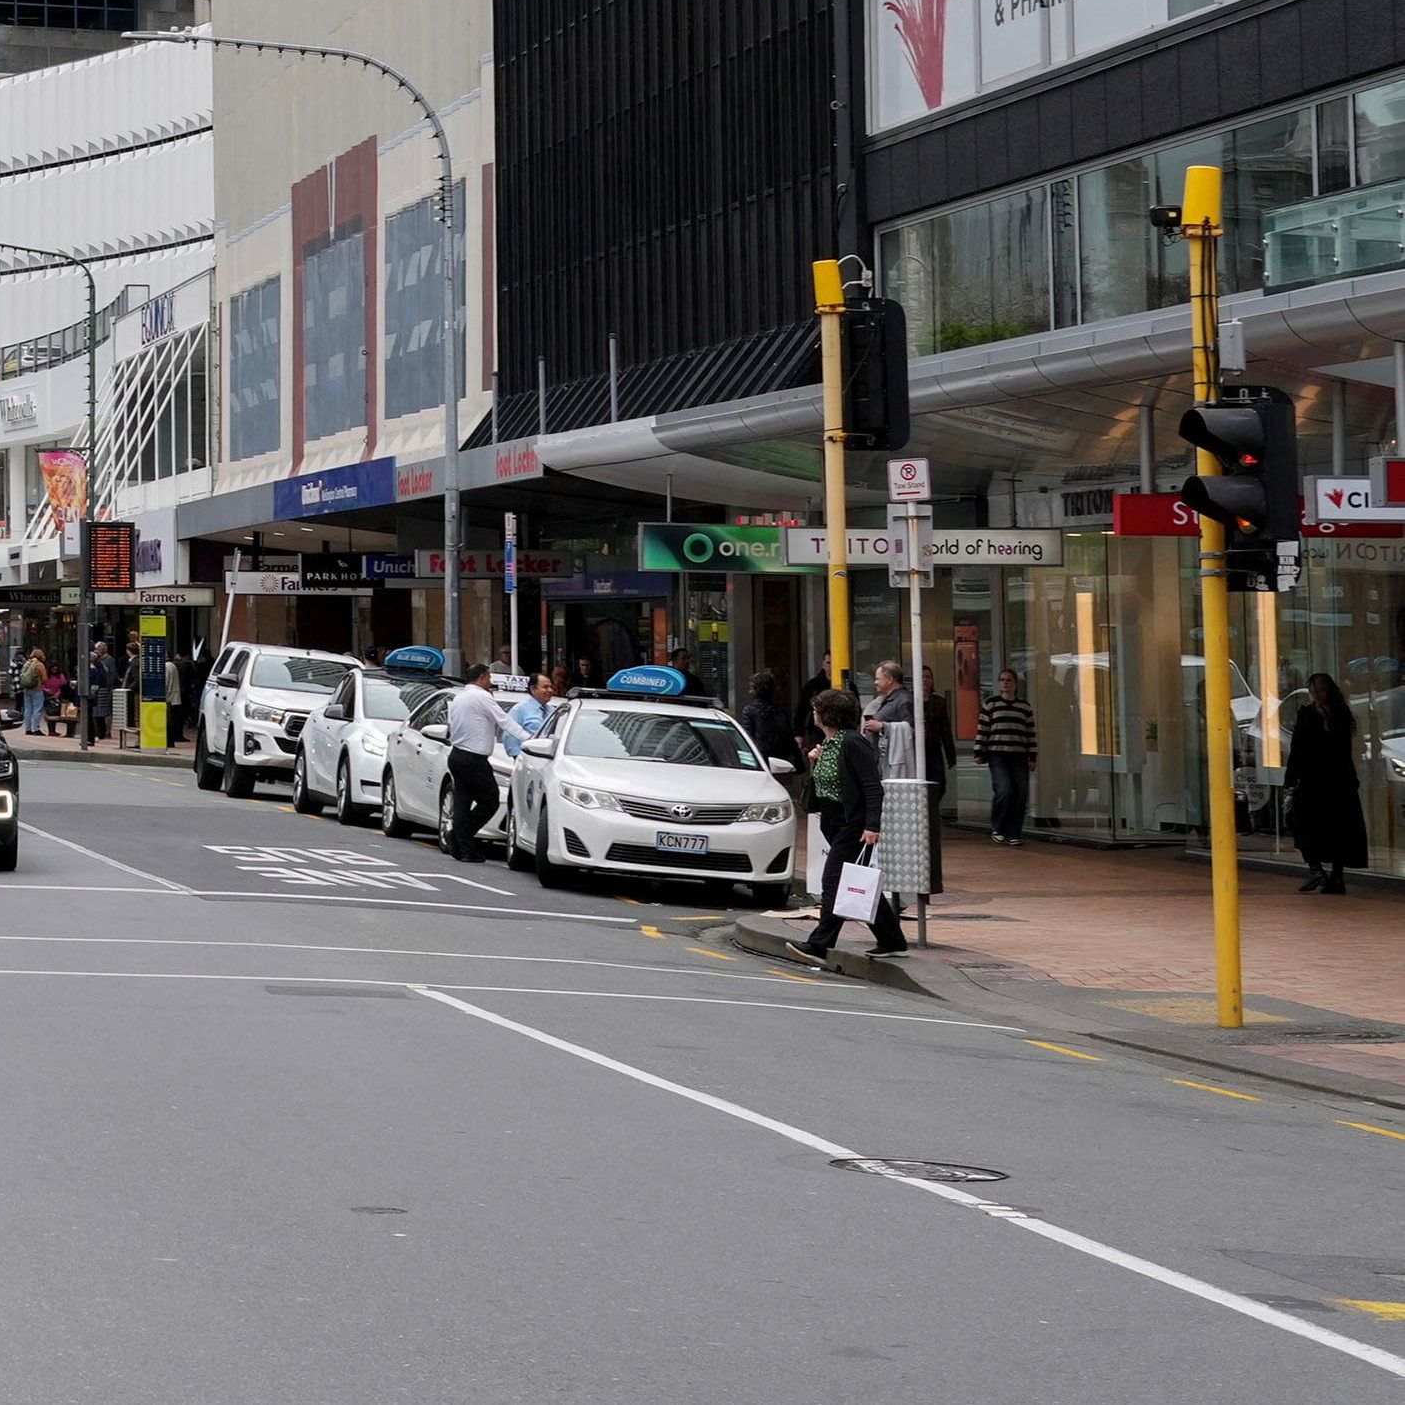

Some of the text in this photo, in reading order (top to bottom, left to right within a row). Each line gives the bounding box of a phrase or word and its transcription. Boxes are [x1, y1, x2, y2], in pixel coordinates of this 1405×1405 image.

[1348, 491, 1369, 508] CI
[810, 537, 1043, 560] TITO orld of hearing
[258, 560, 298, 571] Farme
[373, 560, 415, 574] Unich
[306, 572, 338, 581] PARK
[140, 591, 187, 603] Farmers
[506, 675, 528, 683] TAXI
[620, 675, 666, 687] COMBINED
[659, 835, 706, 849] KCN777
[201, 845, 400, 867] BUS
[236, 866, 517, 896] LANE
